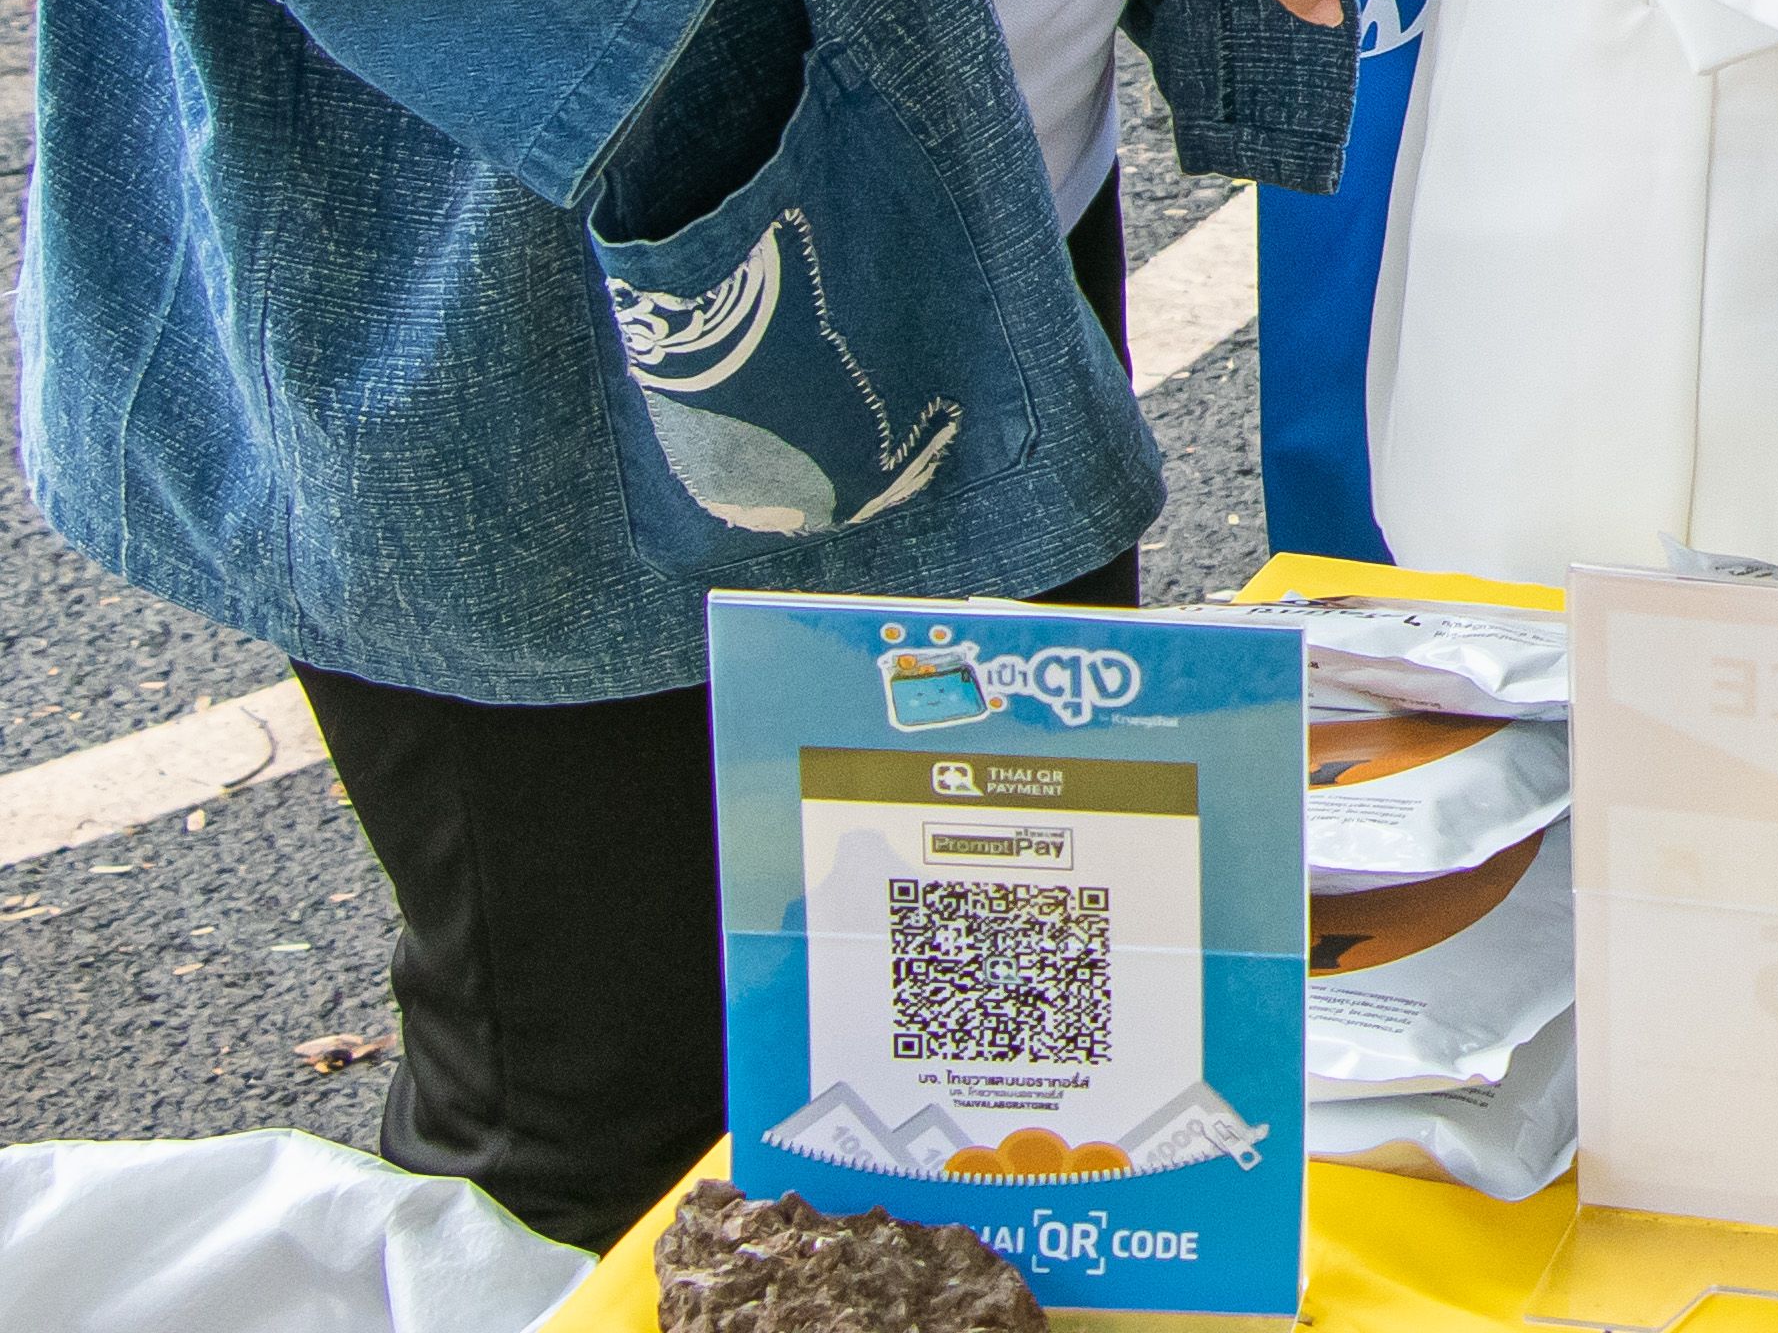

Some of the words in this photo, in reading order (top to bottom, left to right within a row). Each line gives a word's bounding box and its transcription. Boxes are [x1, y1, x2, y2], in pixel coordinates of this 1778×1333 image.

[987, 767, 1032, 782] THAI
[1036, 768, 1063, 783] QR
[986, 781, 1063, 797] PAYMENT
[1038, 1219, 1099, 1260] QR
[1111, 1230, 1199, 1260] CODE
